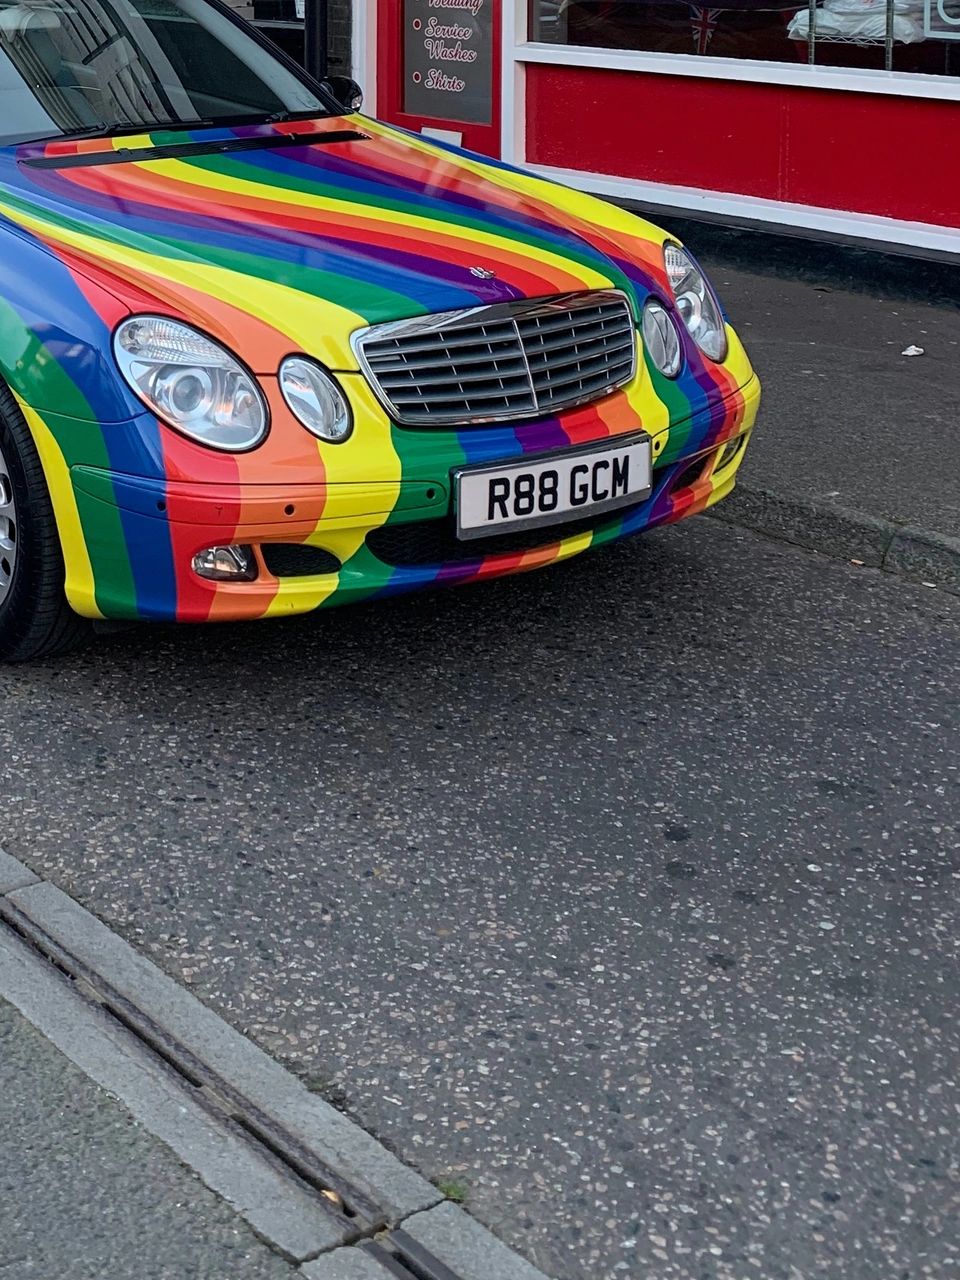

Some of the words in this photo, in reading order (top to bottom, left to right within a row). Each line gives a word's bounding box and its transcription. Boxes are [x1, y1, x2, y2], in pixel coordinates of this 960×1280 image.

[425, 16, 472, 40] Service
[424, 38, 477, 62] Washes
[425, 68, 465, 92] Shirts
[487, 470, 559, 521] R88
[569, 455, 630, 507] GCM
